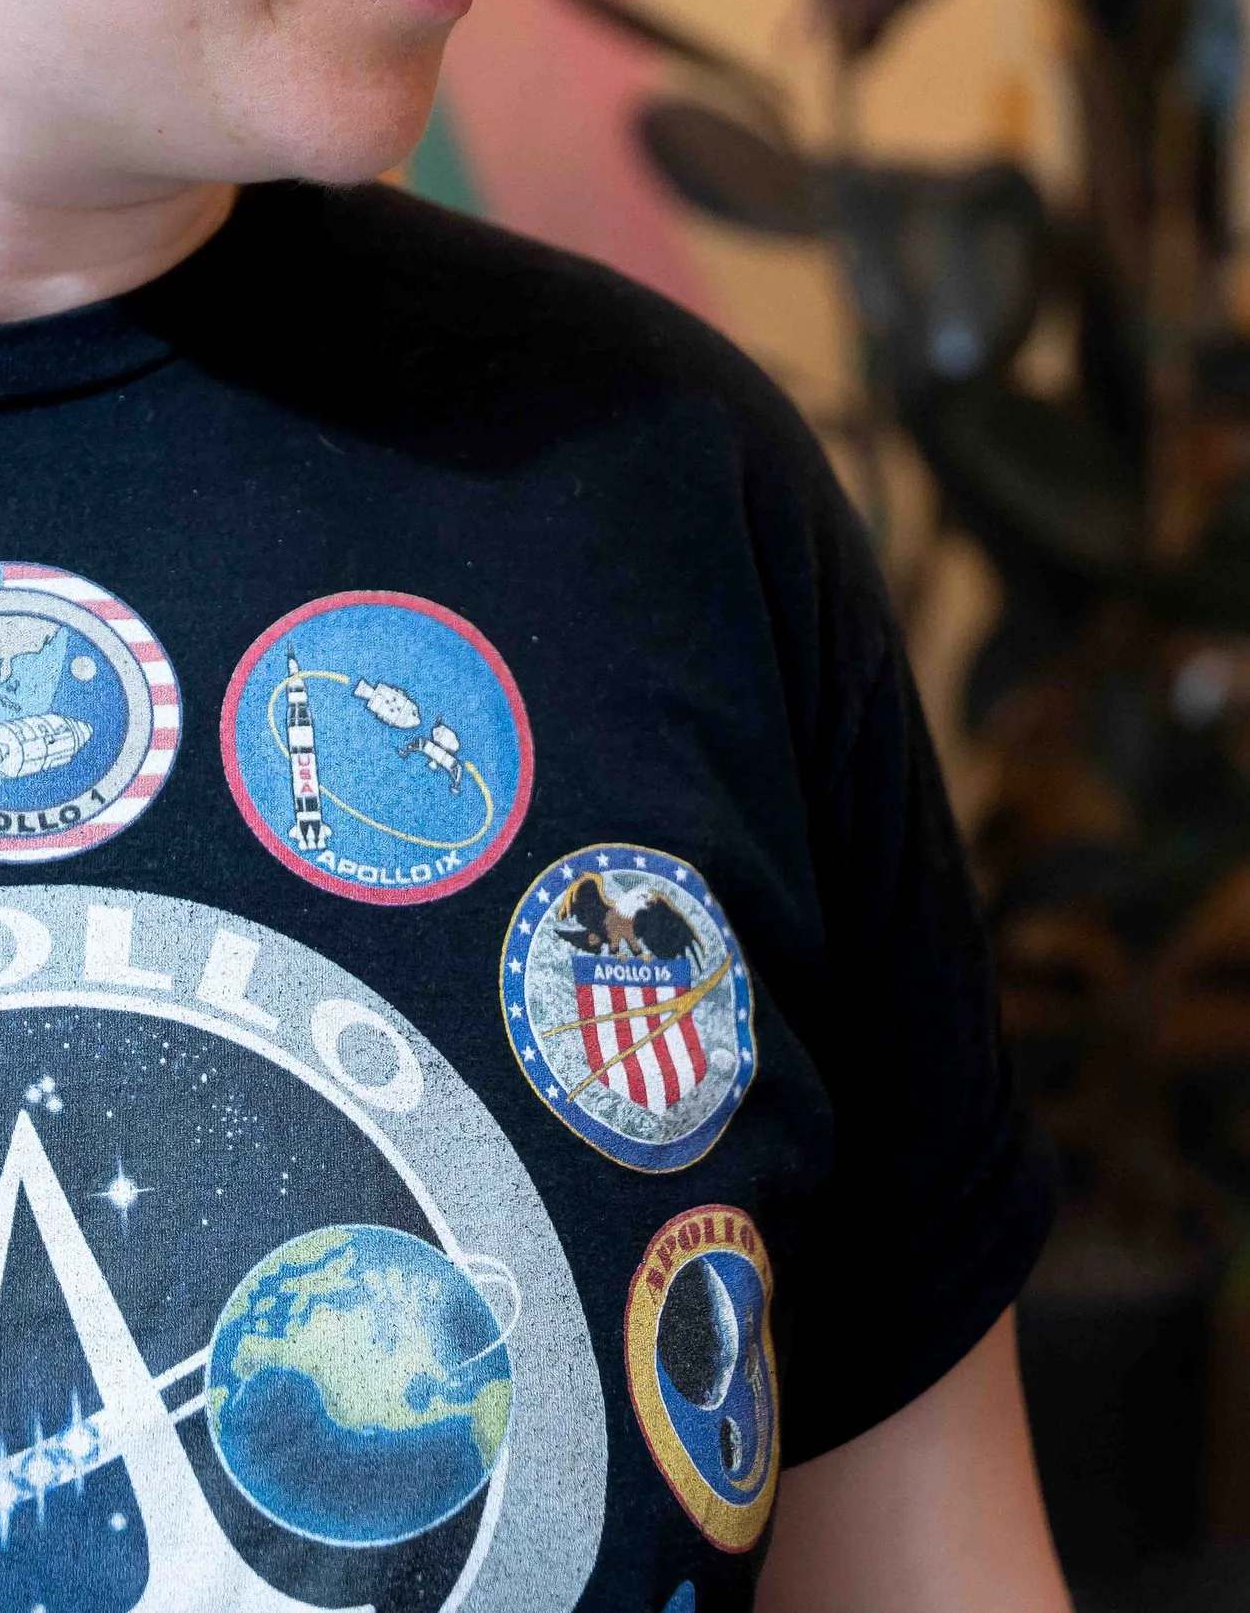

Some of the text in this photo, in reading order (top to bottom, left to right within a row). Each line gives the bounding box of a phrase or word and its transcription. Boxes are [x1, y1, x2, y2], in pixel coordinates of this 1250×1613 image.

[297, 754, 314, 794] USA
[91, 788, 106, 805] 1
[316, 849, 463, 885] APOLLO IX
[594, 963, 671, 982] APOLLO 16
